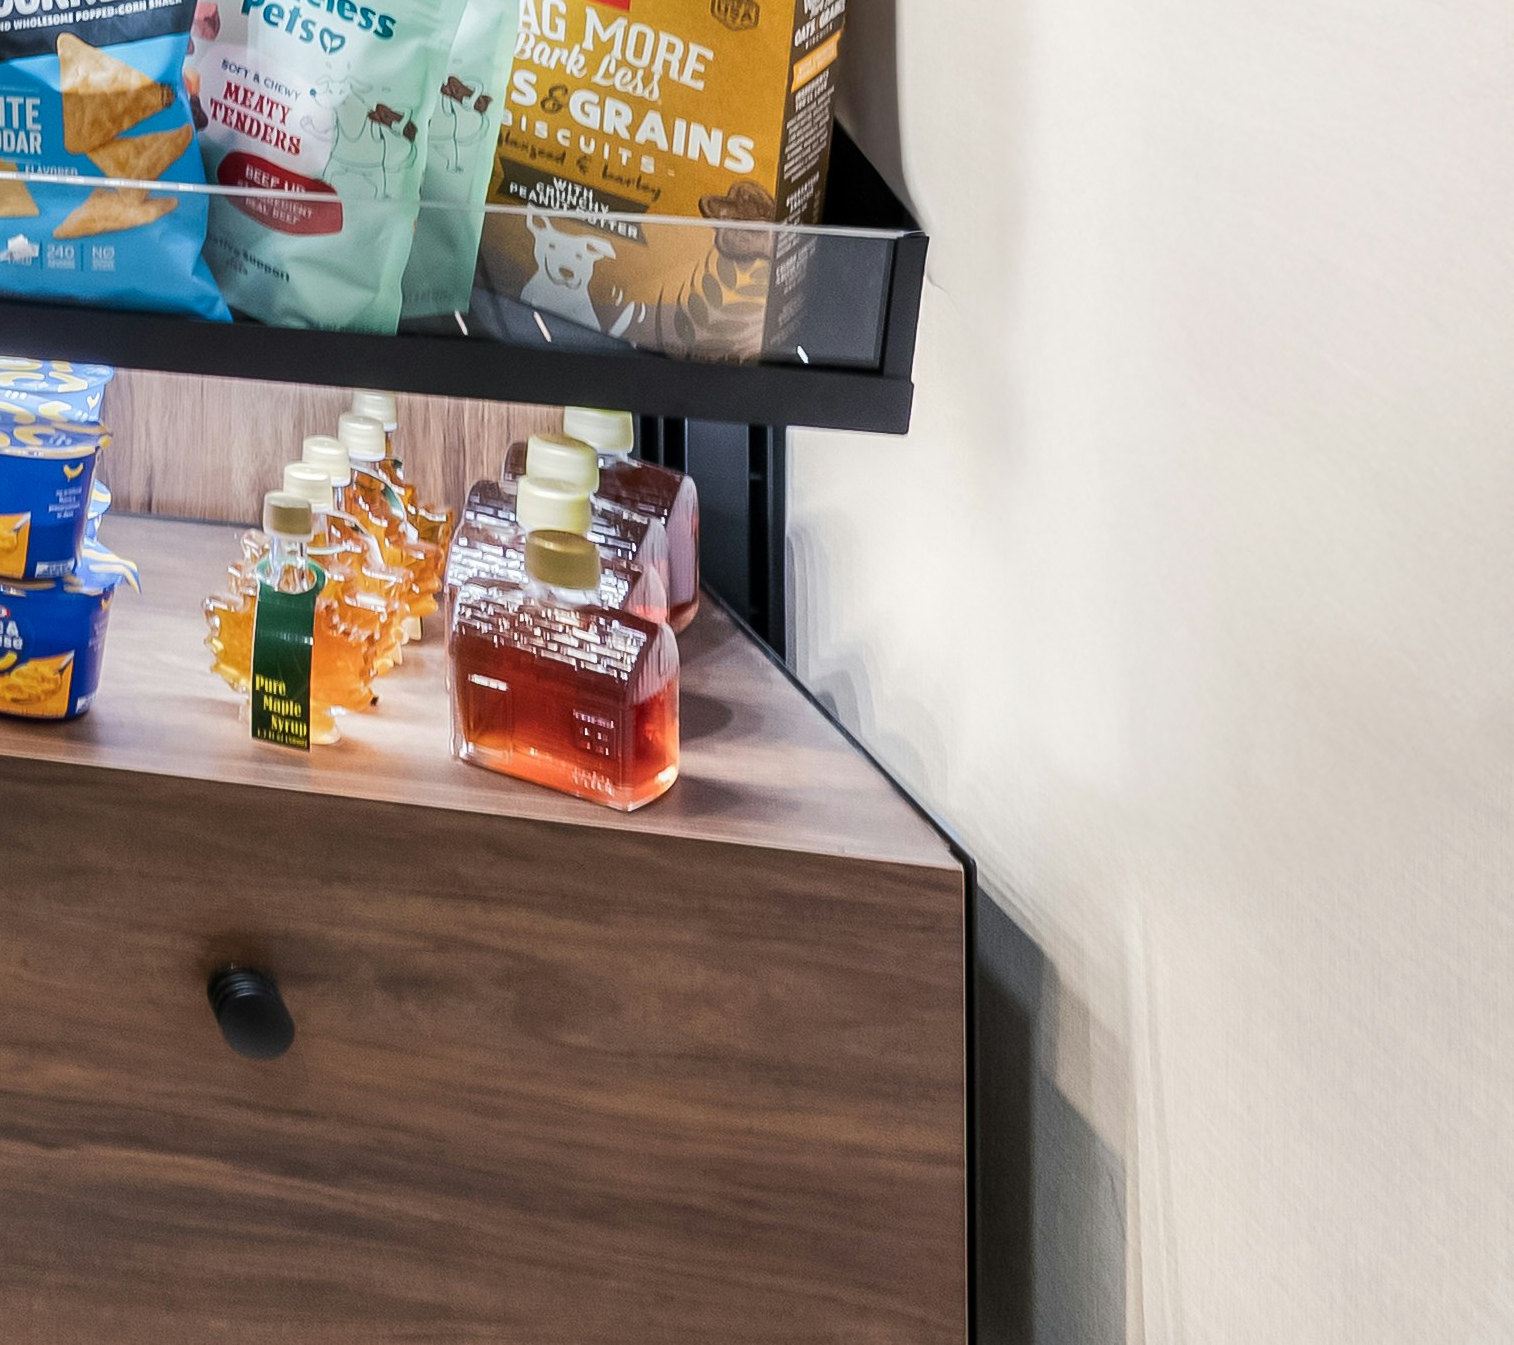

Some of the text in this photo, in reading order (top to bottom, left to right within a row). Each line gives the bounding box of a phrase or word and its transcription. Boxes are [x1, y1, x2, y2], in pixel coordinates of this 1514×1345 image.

[515, 36, 661, 101] Bark Less
[583, 7, 714, 92] MORE
[210, 100, 302, 156] TENDERS
[223, 81, 291, 126] MEATY
[570, 85, 755, 175] GRAINS
[255, 673, 286, 695] Pure
[263, 696, 302, 717] Maple
